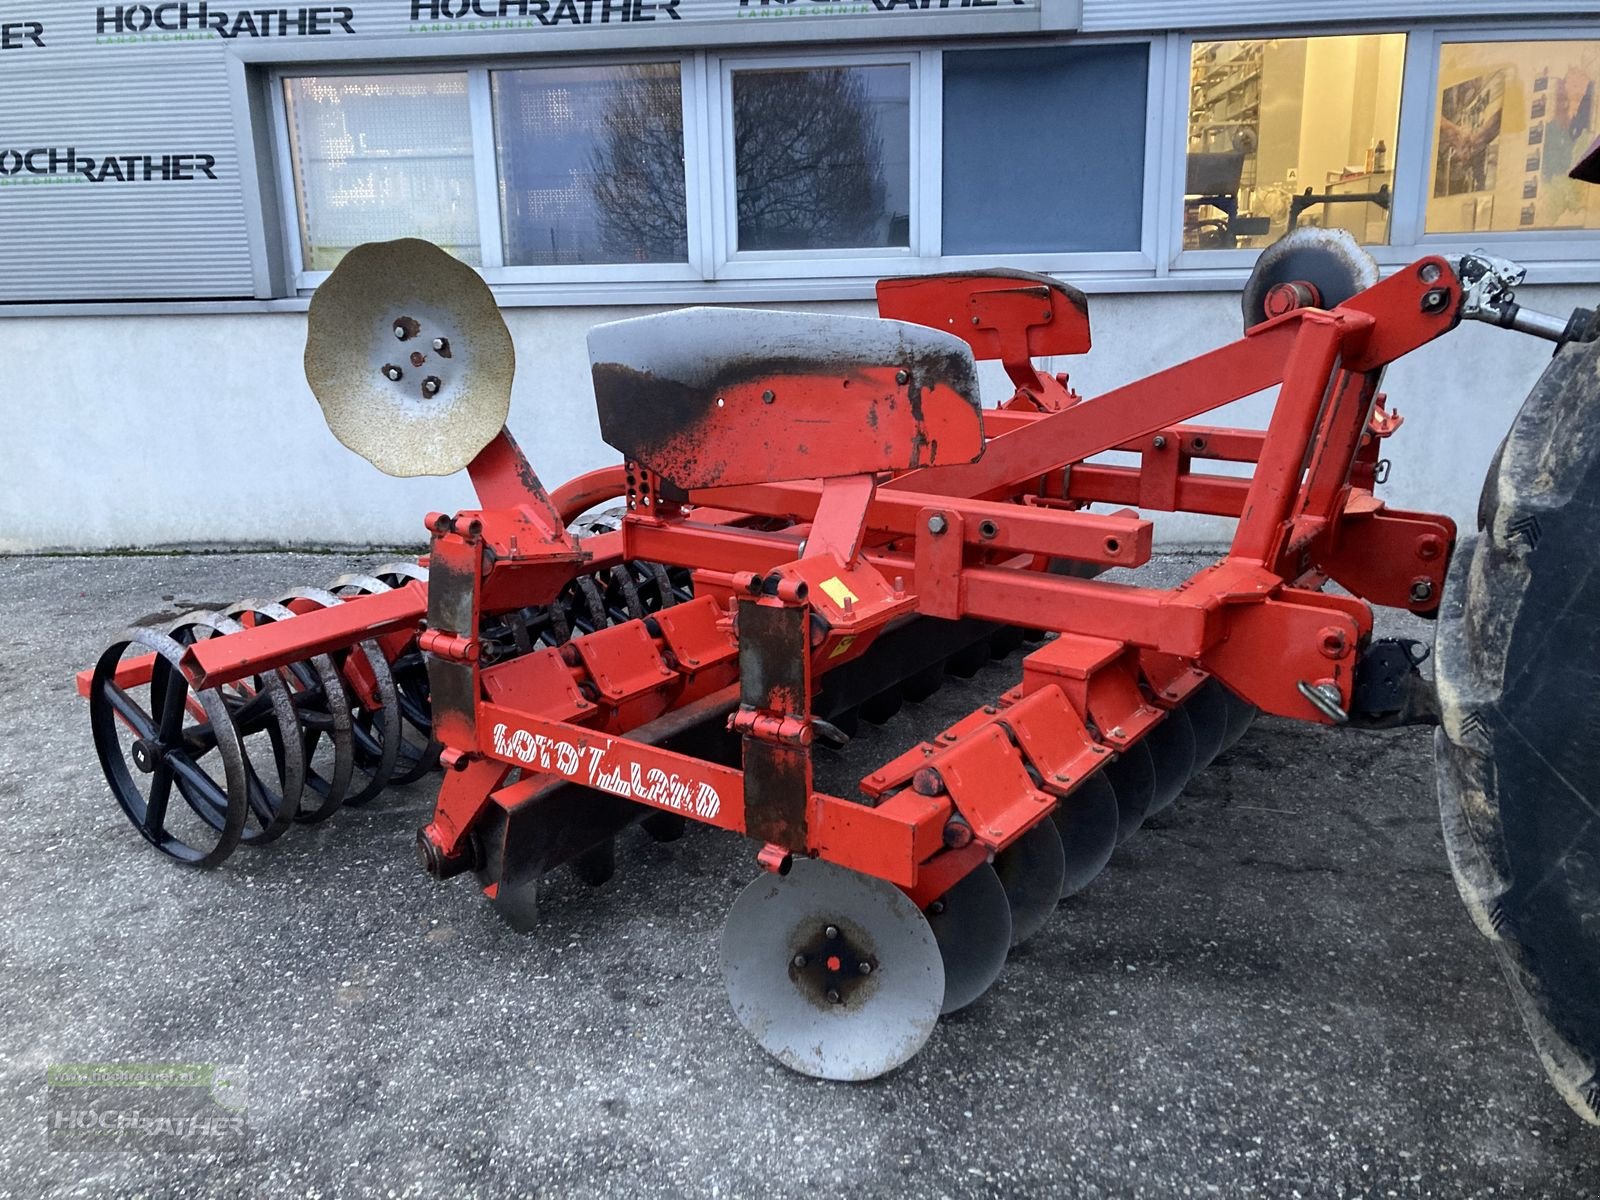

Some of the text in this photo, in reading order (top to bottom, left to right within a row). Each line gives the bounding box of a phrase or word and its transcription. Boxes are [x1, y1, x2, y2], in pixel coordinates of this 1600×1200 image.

[737, 4, 869, 18] LANDTECHNIK
[96, 2, 356, 38] HOCHRATHER
[408, 19, 535, 33] LANDTECHNIK
[96, 31, 215, 44] LANDTECHNIK
